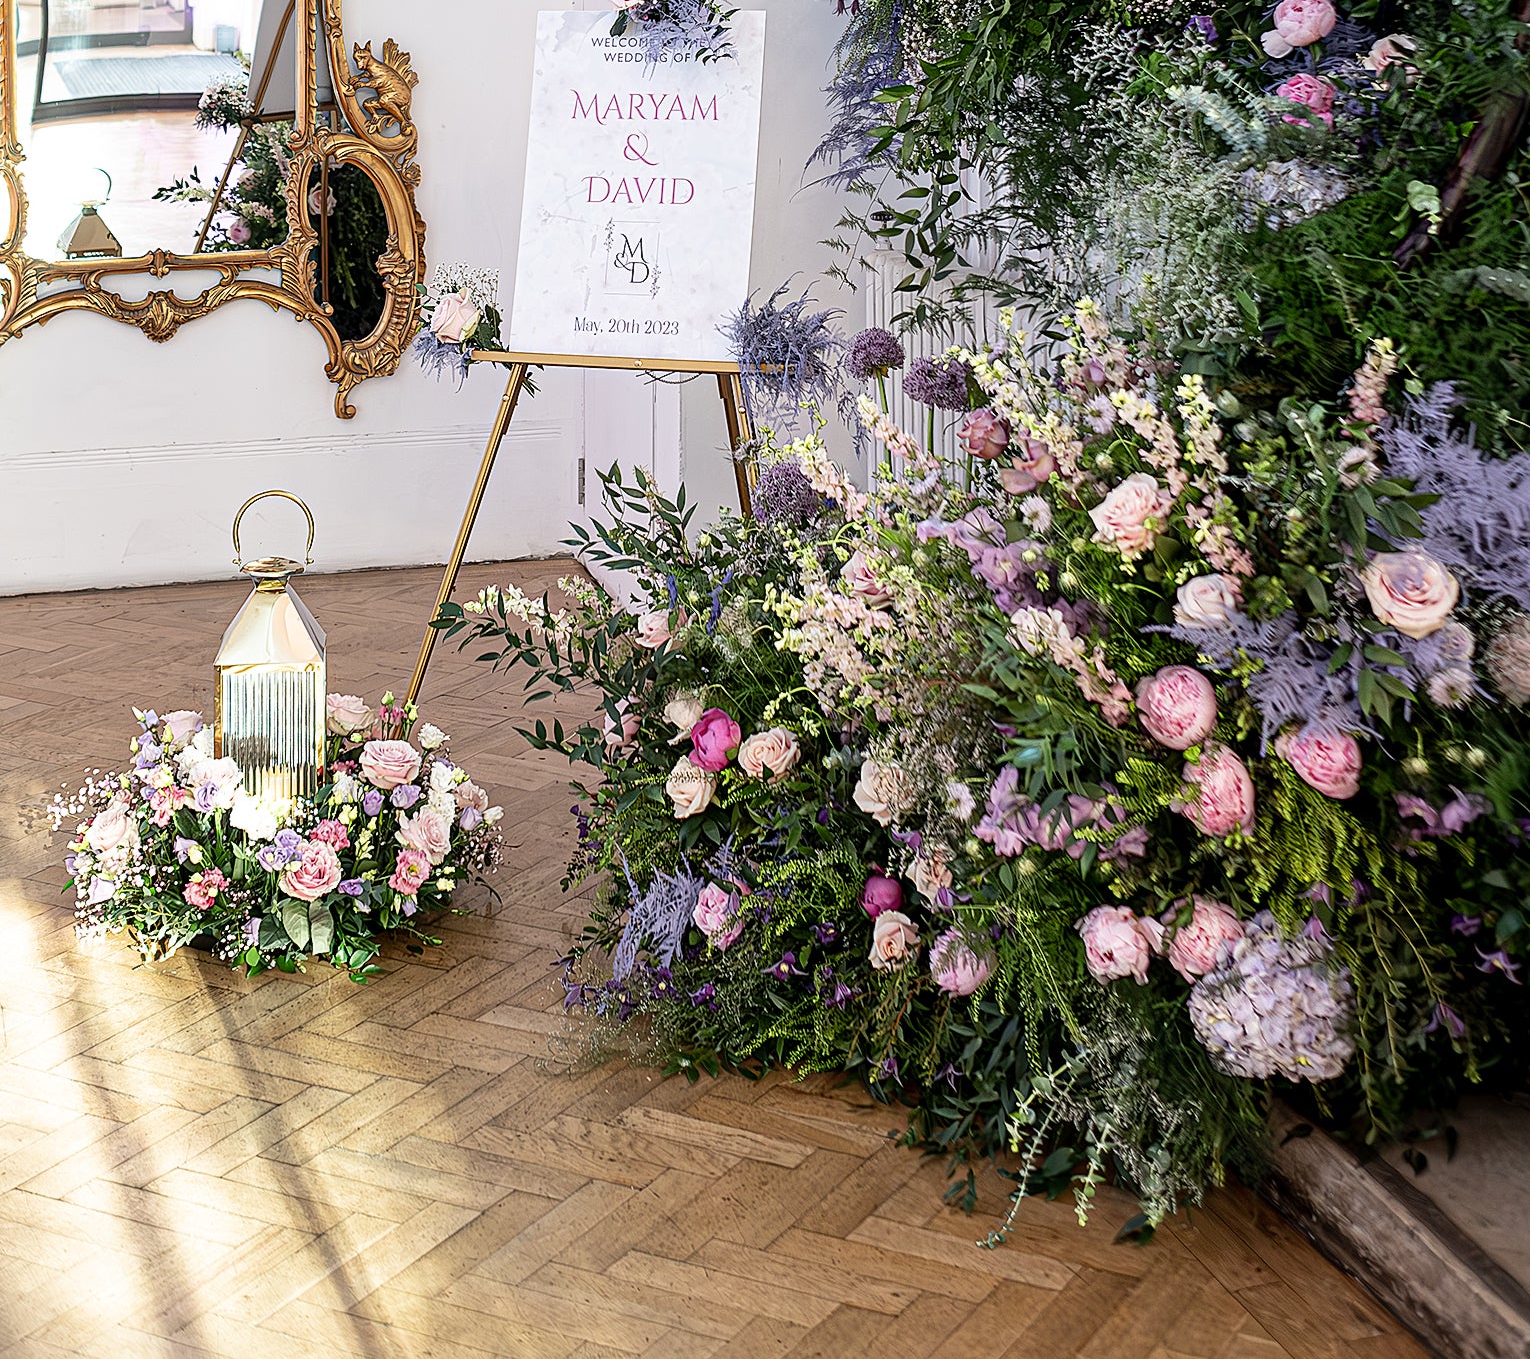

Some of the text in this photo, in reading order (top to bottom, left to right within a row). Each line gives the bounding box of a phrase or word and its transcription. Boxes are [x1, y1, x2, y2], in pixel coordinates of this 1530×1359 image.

[604, 52, 691, 63] WEDDING OF
[570, 89, 720, 126] MARYAM
[623, 129, 660, 166] &
[581, 176, 695, 205] DAVID
[573, 316, 680, 336] May, 20th 2023
